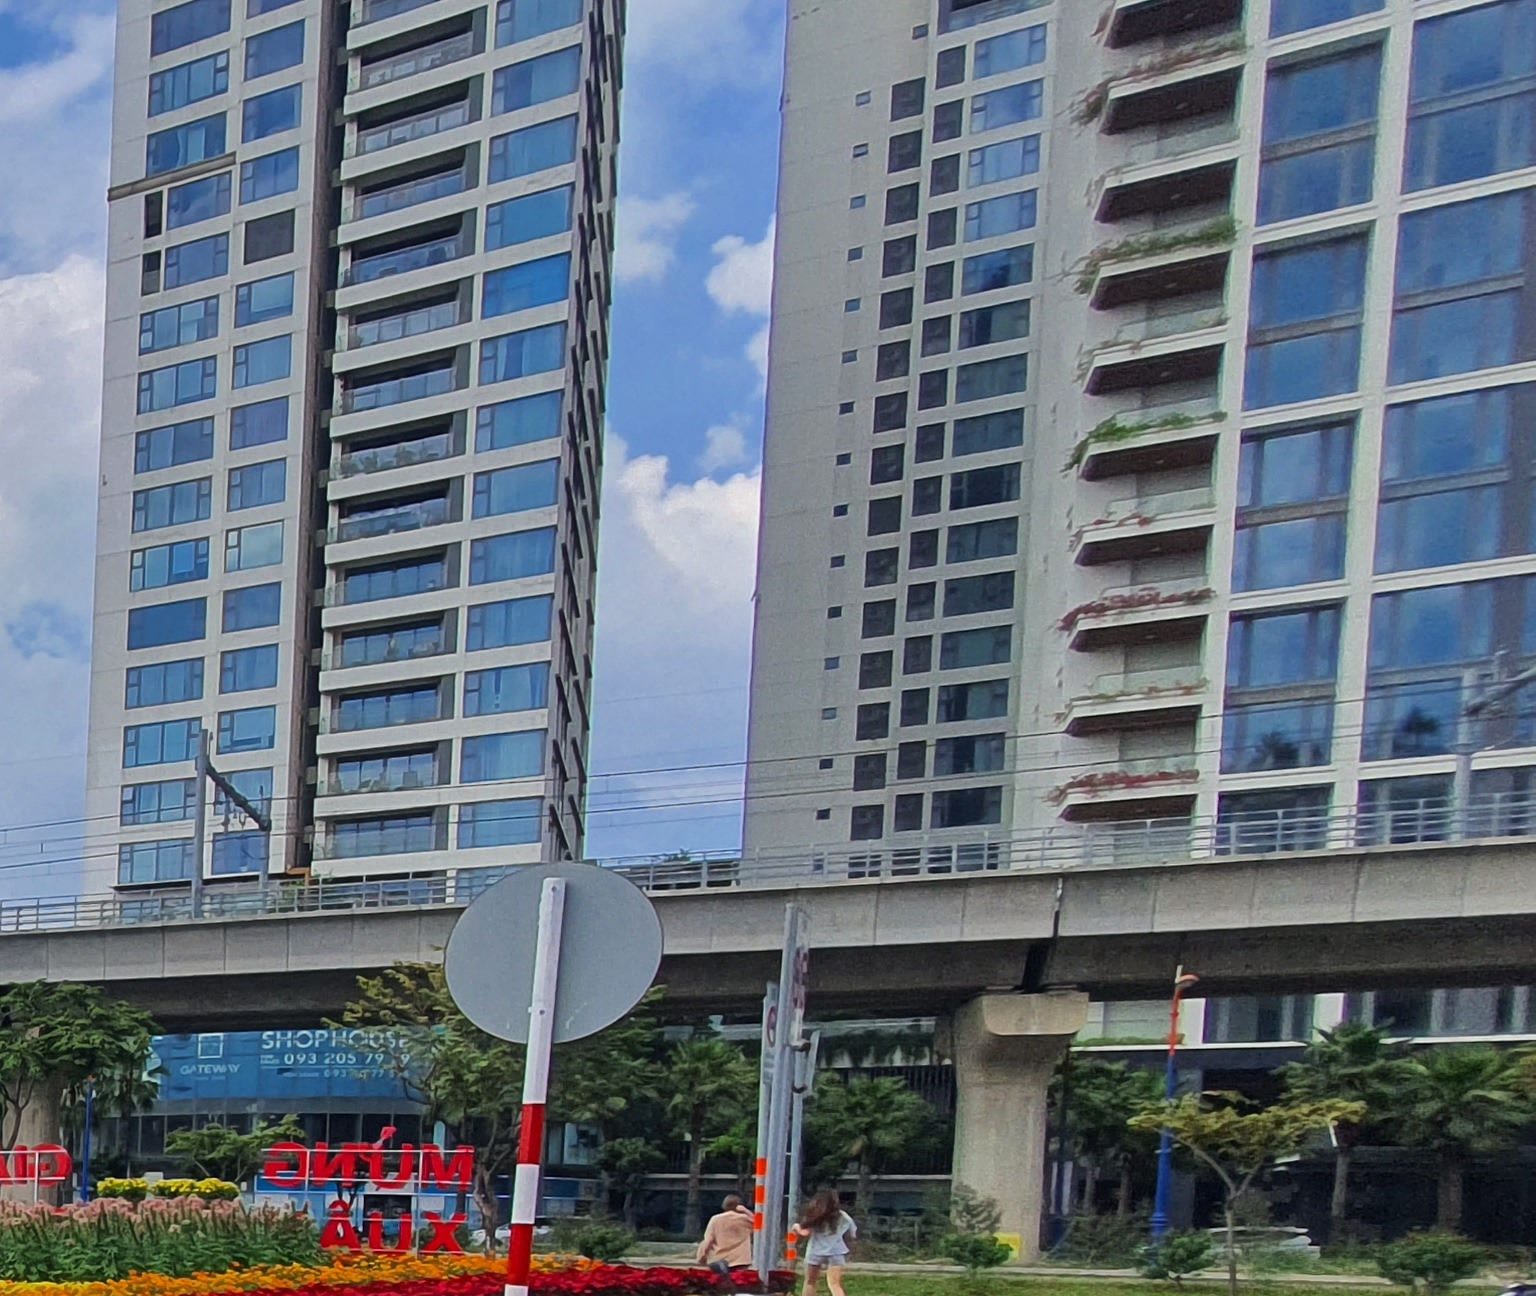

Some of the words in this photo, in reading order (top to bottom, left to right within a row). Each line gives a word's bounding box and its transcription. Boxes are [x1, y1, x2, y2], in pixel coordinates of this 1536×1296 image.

[283, 1052, 317, 1065] 093
[323, 1052, 357, 1065] 205
[180, 1063, 241, 1075] GATEWAY
